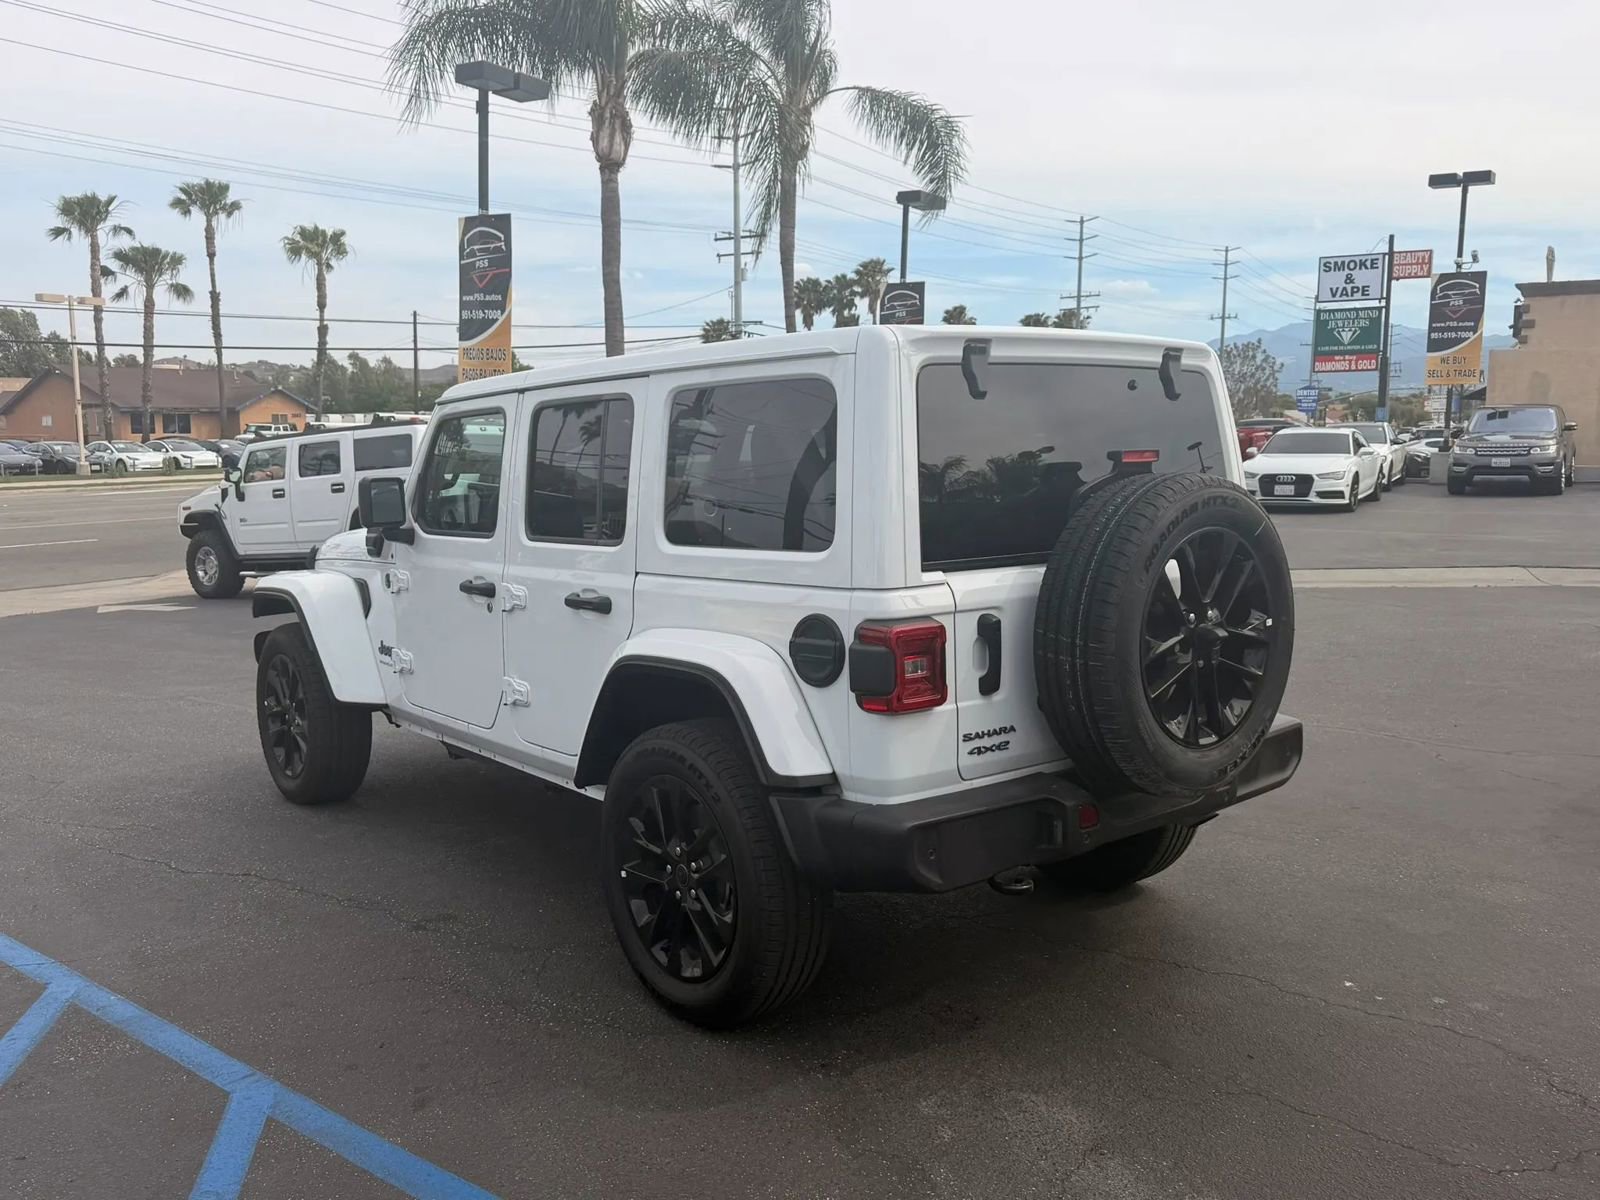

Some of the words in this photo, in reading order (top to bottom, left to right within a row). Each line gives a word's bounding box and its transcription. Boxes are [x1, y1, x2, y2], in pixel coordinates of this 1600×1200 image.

[1393, 251, 1430, 264] BEAUTY
[1322, 258, 1380, 273] SMOKE
[1392, 264, 1430, 277] SUPPLY
[1344, 273, 1356, 285] &
[1329, 285, 1371, 298] VAPE
[1320, 311, 1357, 320] DIAMOND
[1357, 310, 1379, 318] MIND
[1327, 319, 1370, 329] JEWELERS
[485, 348, 507, 361] BAJOS
[1440, 356, 1450, 365] WE
[1452, 356, 1467, 364] BUY
[1314, 360, 1350, 371] DIAMONDS
[1350, 360, 1356, 370] &
[1357, 360, 1376, 370] GOLD
[1427, 369, 1444, 378] SELL
[1453, 369, 1477, 378] TRADE
[962, 724, 1016, 742] SAHARA
